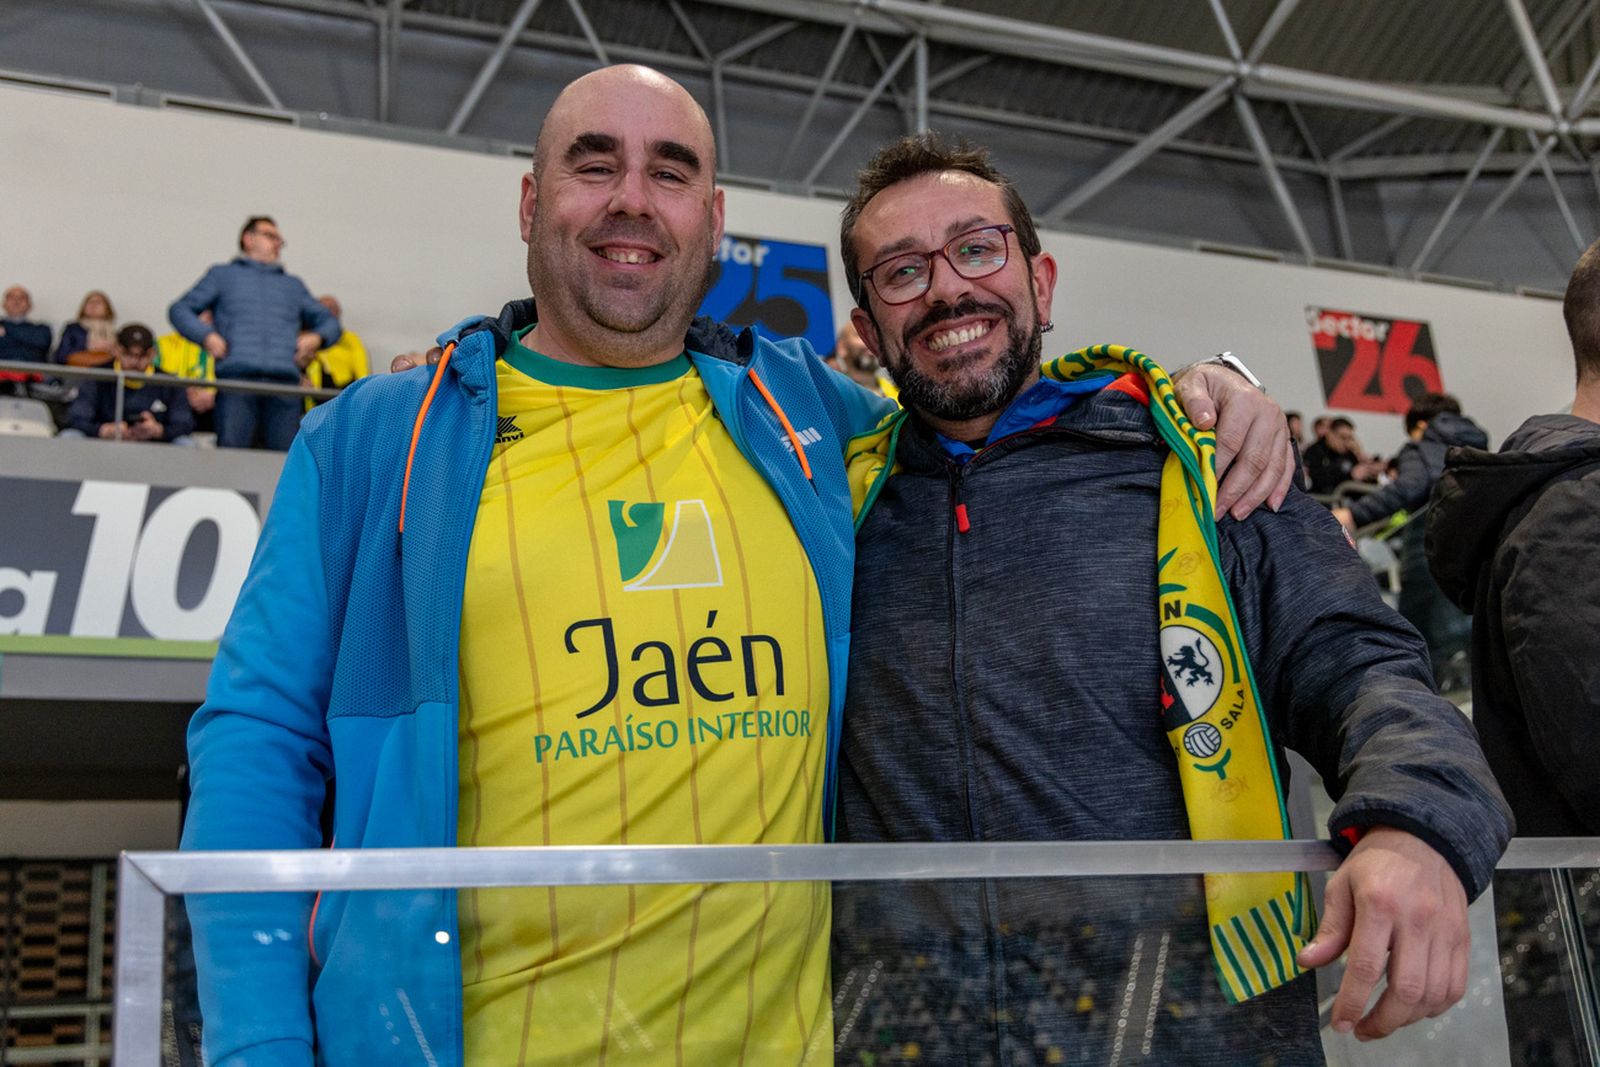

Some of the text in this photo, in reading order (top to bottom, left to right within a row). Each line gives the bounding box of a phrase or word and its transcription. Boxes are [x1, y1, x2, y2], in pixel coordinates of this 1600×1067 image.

[713, 237, 770, 267] tor
[1305, 305, 1389, 342] Sector
[1313, 309, 1443, 415] 26
[69, 480, 261, 641] 10
[564, 610, 785, 719] Jaén
[534, 709, 812, 763] PARAÍSO INTERIOR
[1220, 689, 1245, 730] SALA
